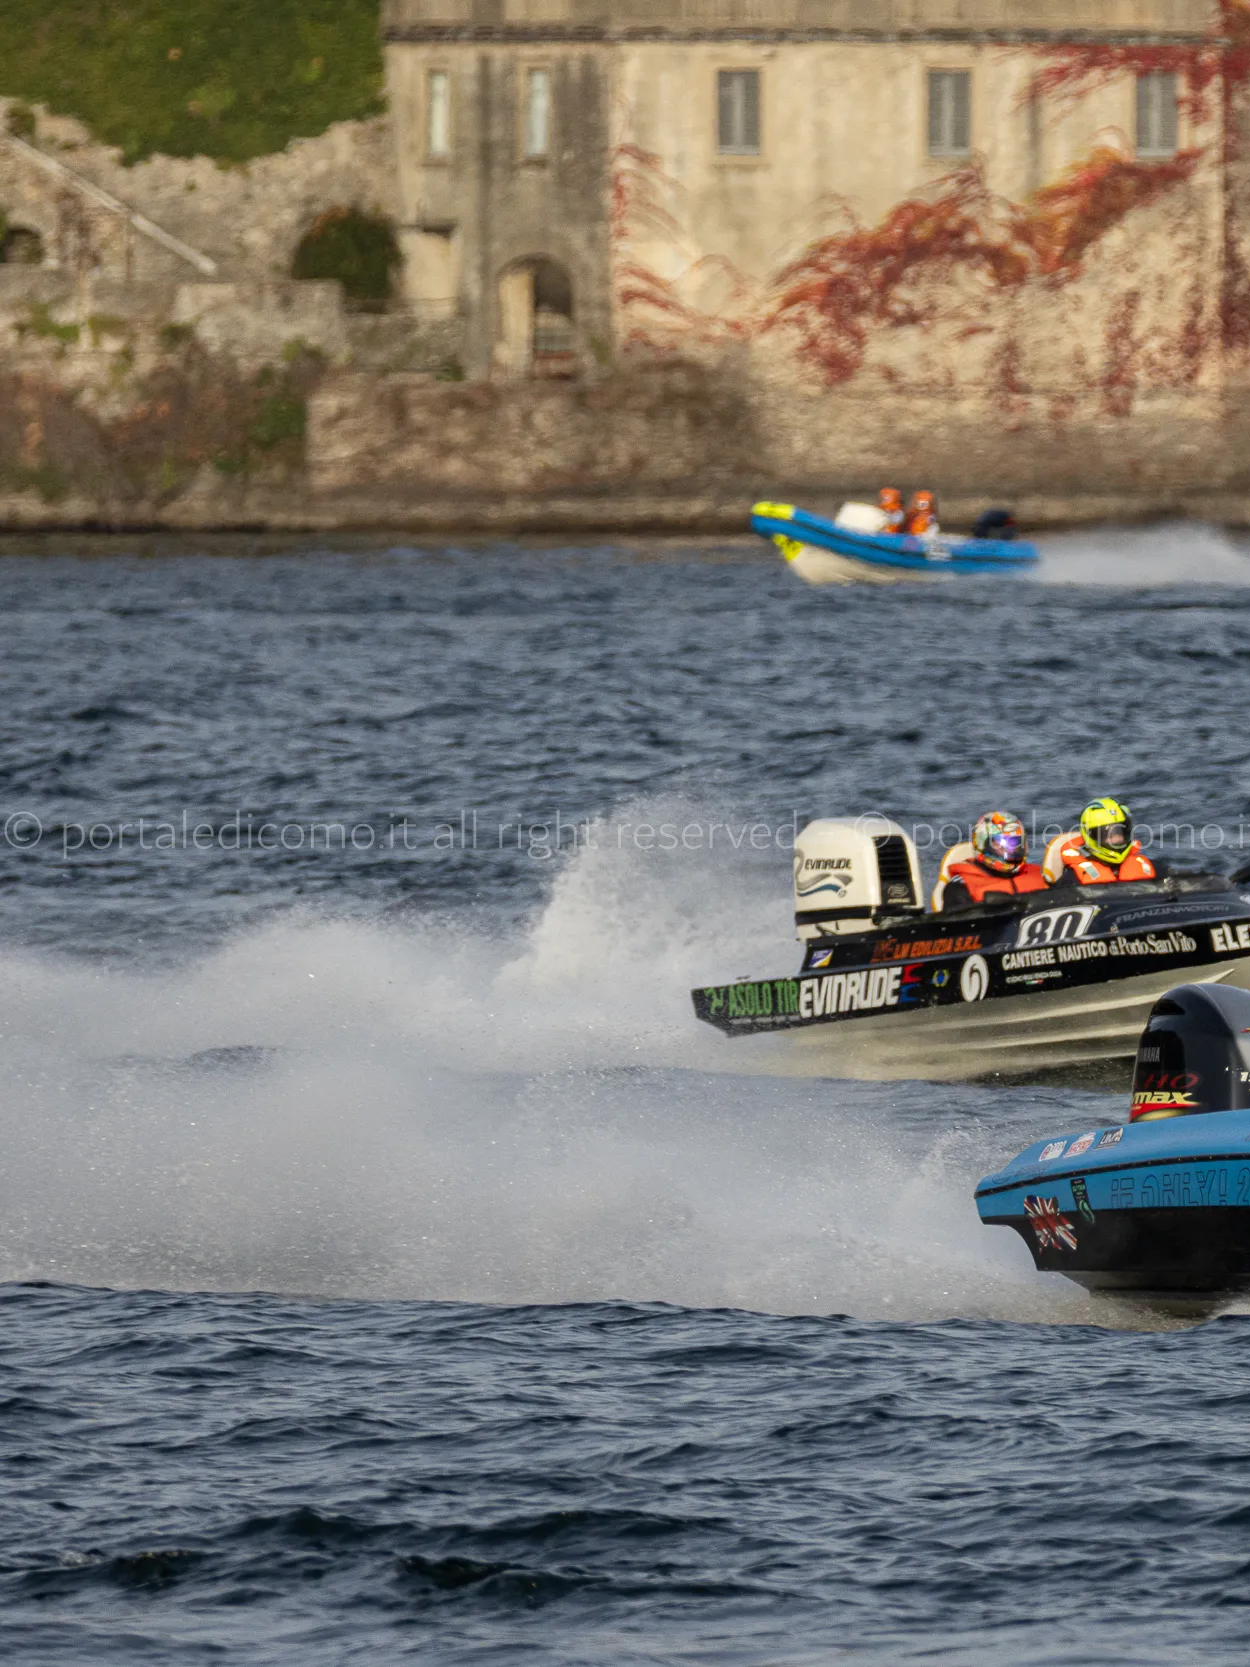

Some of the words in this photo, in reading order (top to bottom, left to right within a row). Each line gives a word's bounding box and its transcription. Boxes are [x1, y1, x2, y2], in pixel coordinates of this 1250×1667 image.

[804, 858, 852, 870] EVINRUDE
[1023, 911, 1084, 947] 80
[1002, 949, 1056, 970] CANTIERE
[1058, 940, 1108, 963] NAUTICO
[800, 966, 902, 1019] EVINRUDE
